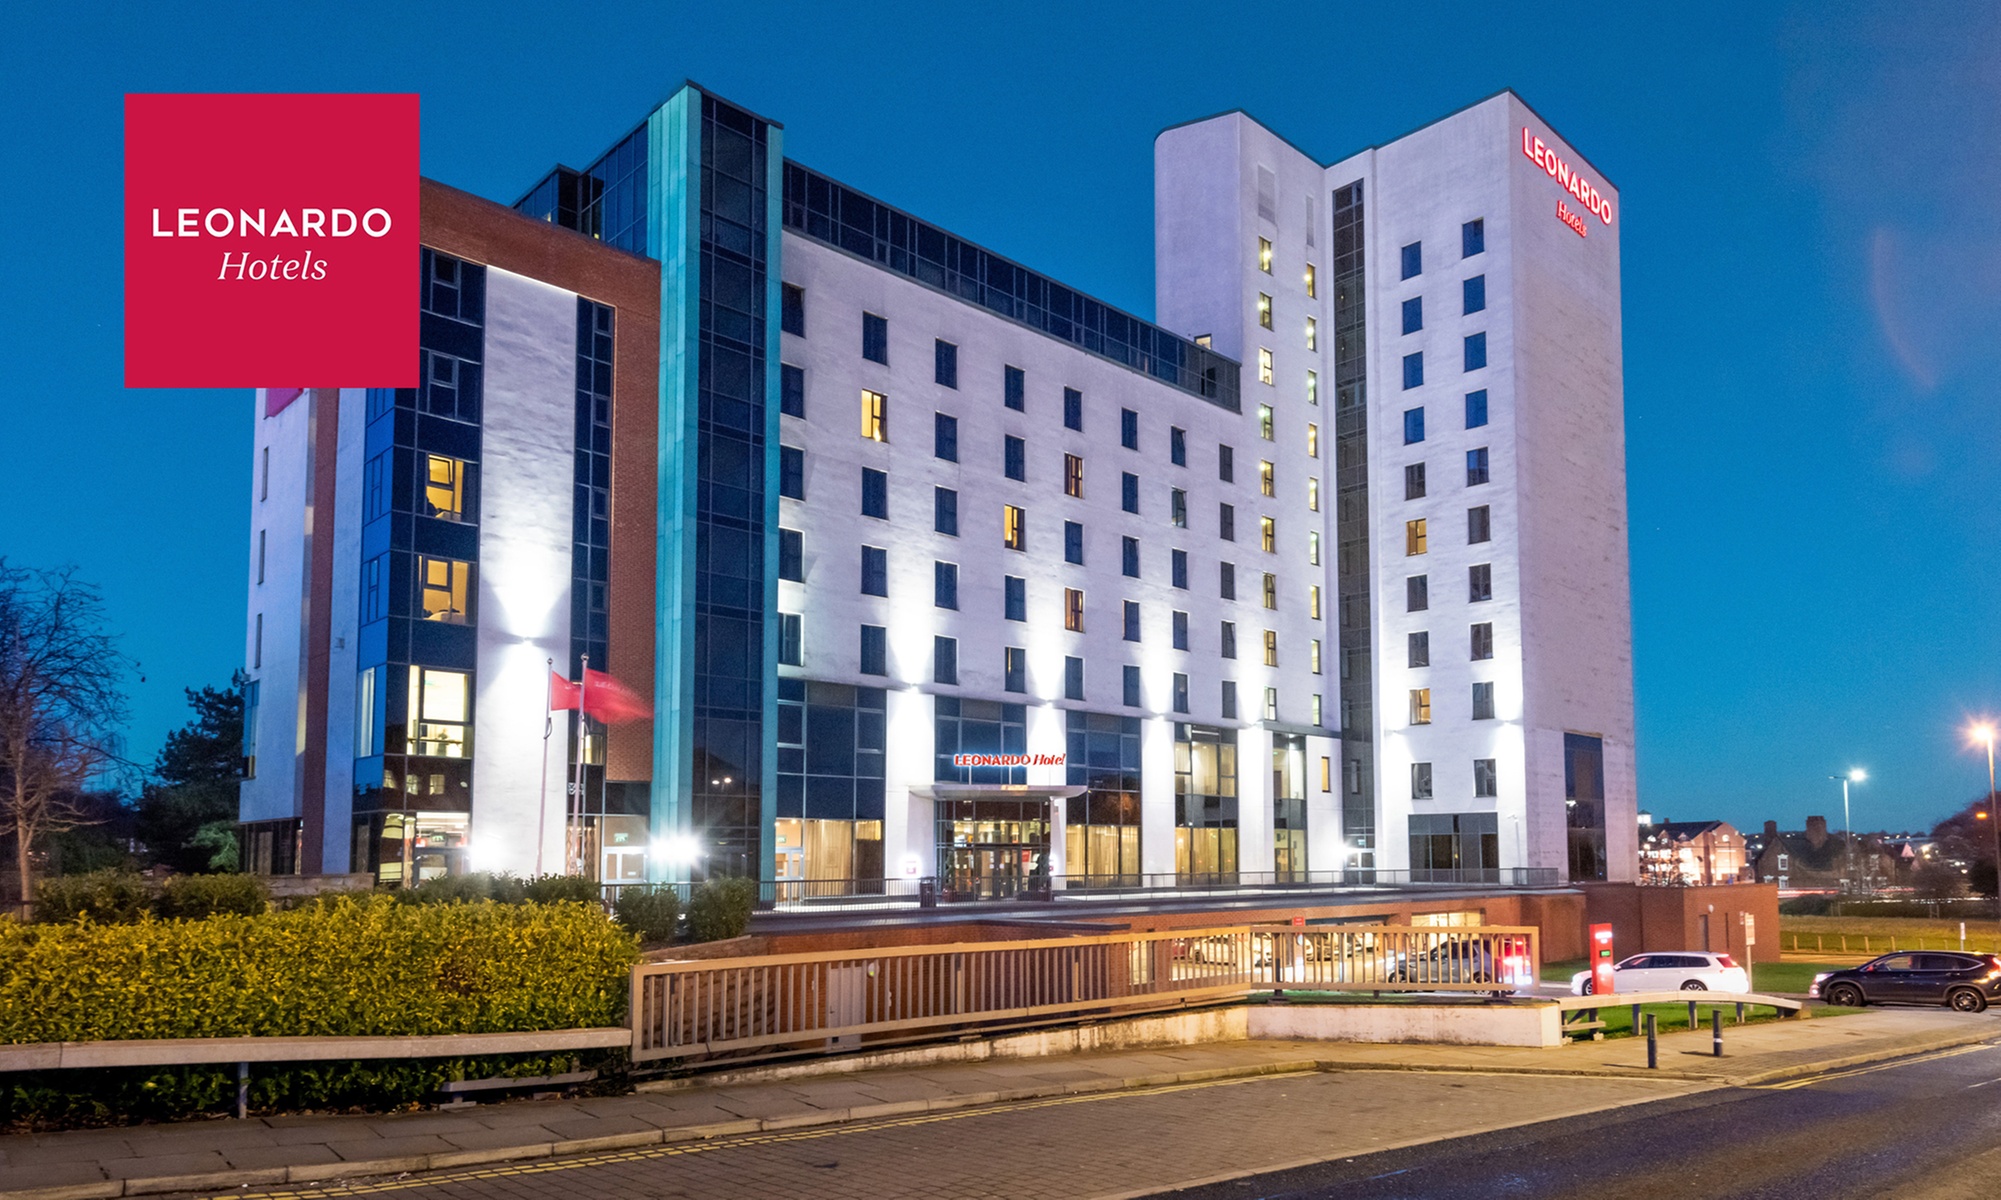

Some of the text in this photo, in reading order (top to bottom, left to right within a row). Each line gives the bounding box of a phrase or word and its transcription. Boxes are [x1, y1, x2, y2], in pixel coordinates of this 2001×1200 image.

[1522, 127, 1613, 226] LEONARDO
[1556, 200, 1588, 238] Hotels
[954, 753, 1066, 766] LEONARDO Hotel
